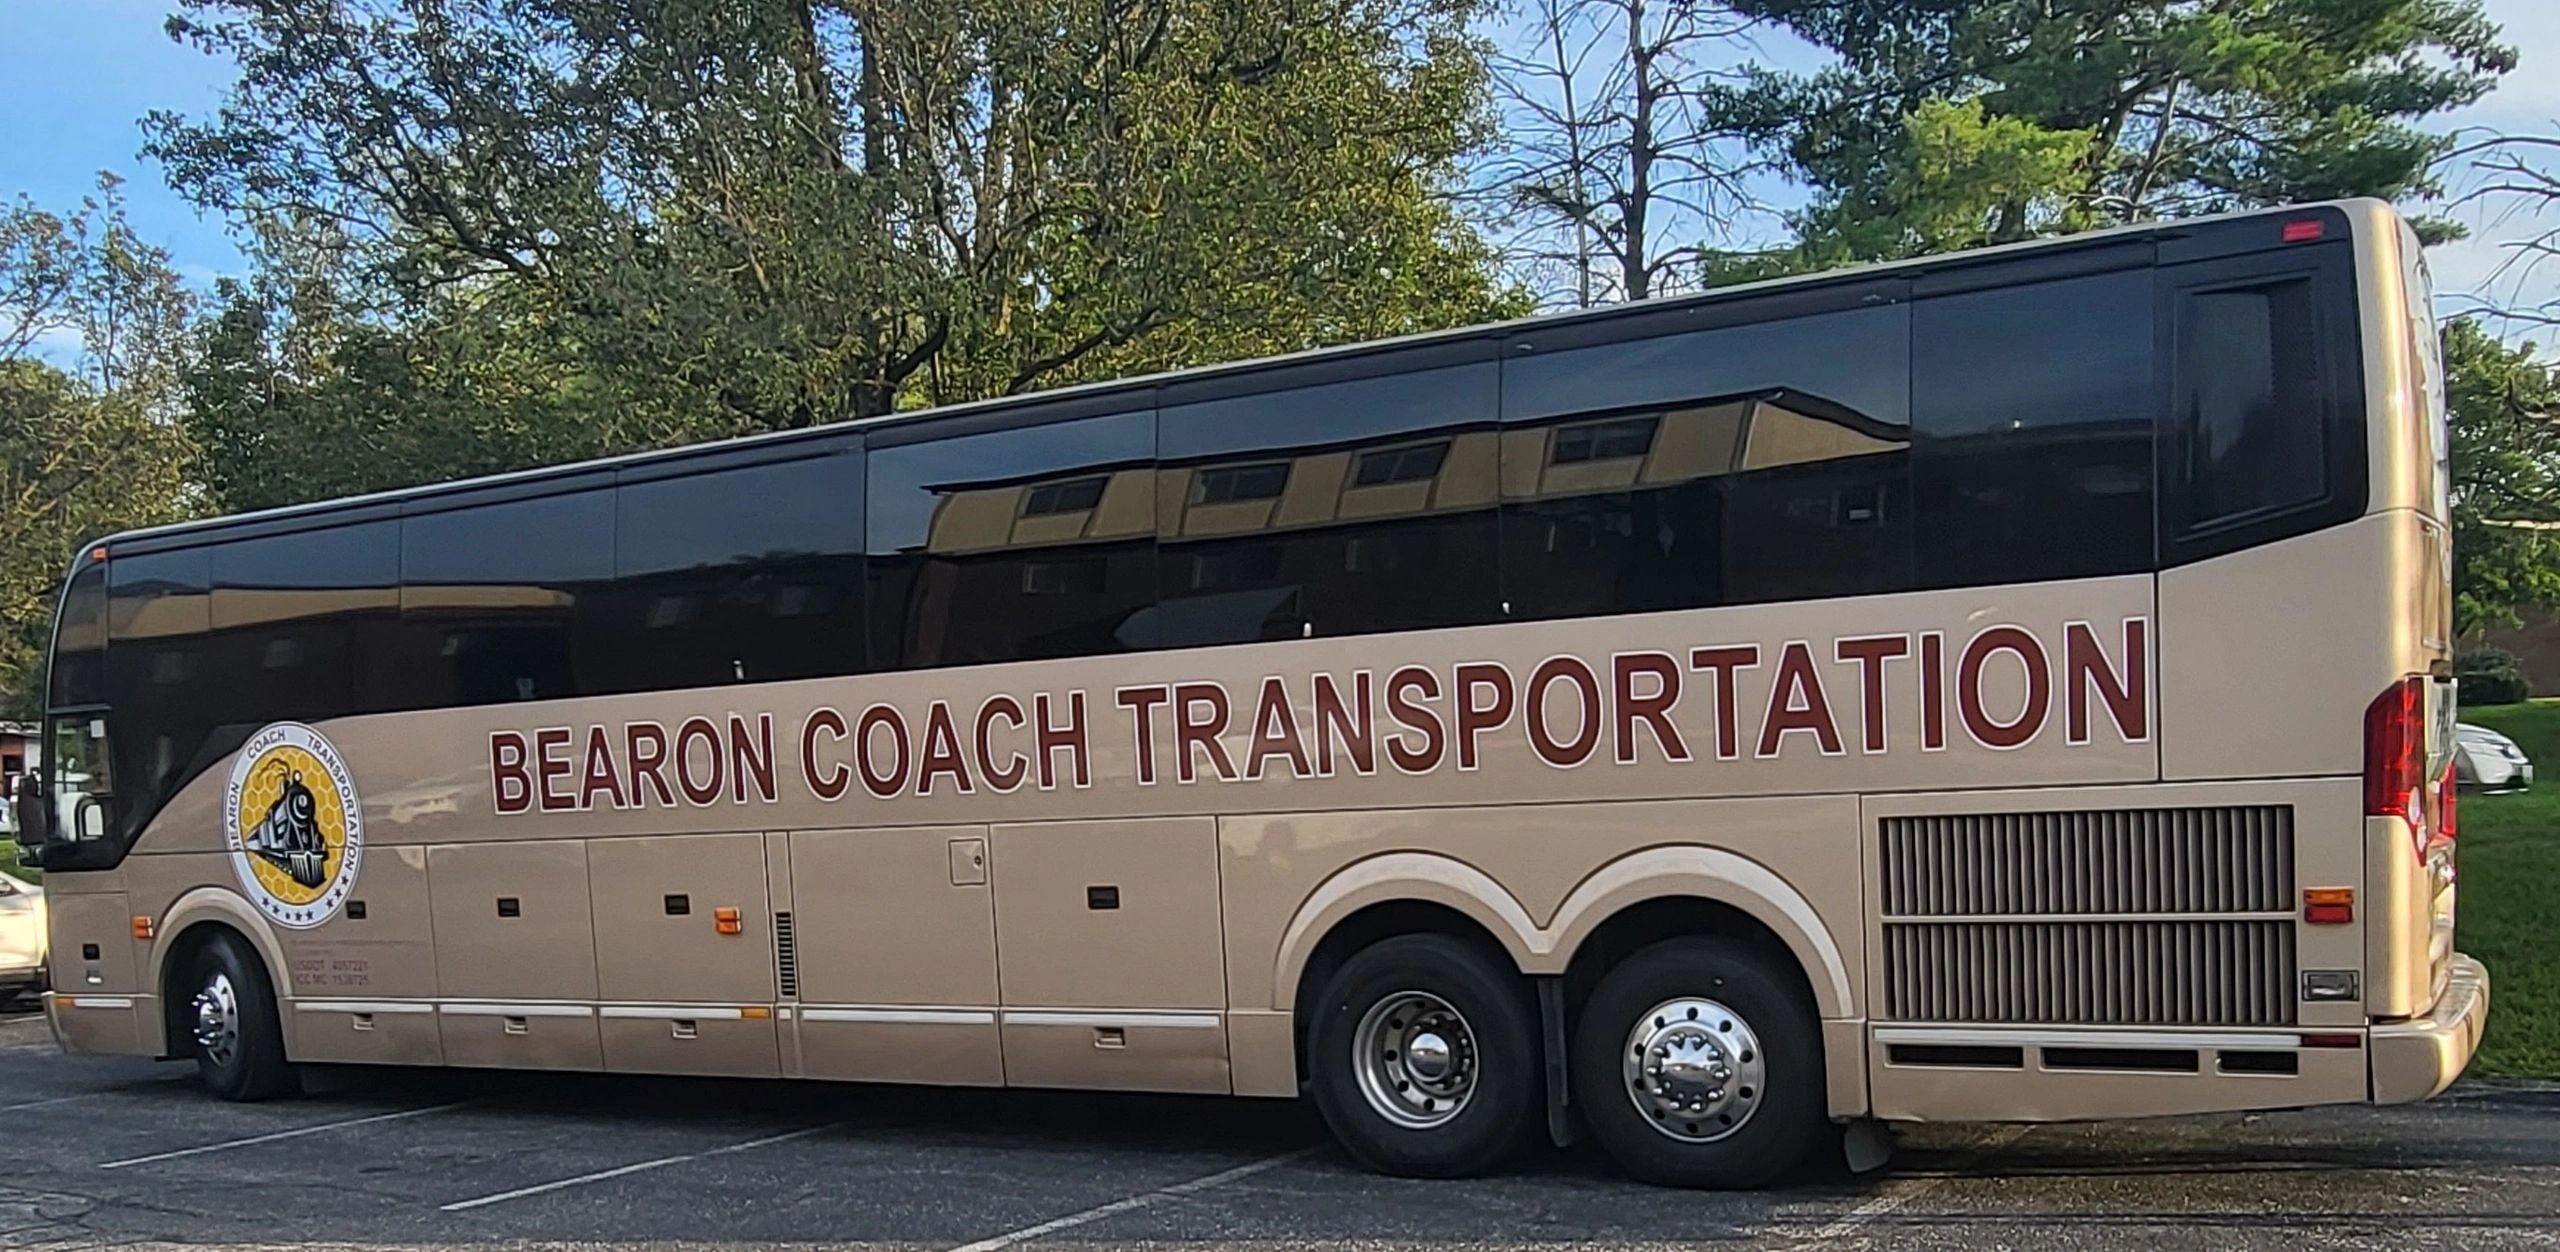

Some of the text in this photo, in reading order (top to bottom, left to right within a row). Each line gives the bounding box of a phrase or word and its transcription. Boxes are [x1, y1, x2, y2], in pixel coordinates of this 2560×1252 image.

[228, 728, 359, 871] BEARON COACH TRANSPORTATION
[490, 617, 2150, 814] BEARON COACH TRANSPORTATION
